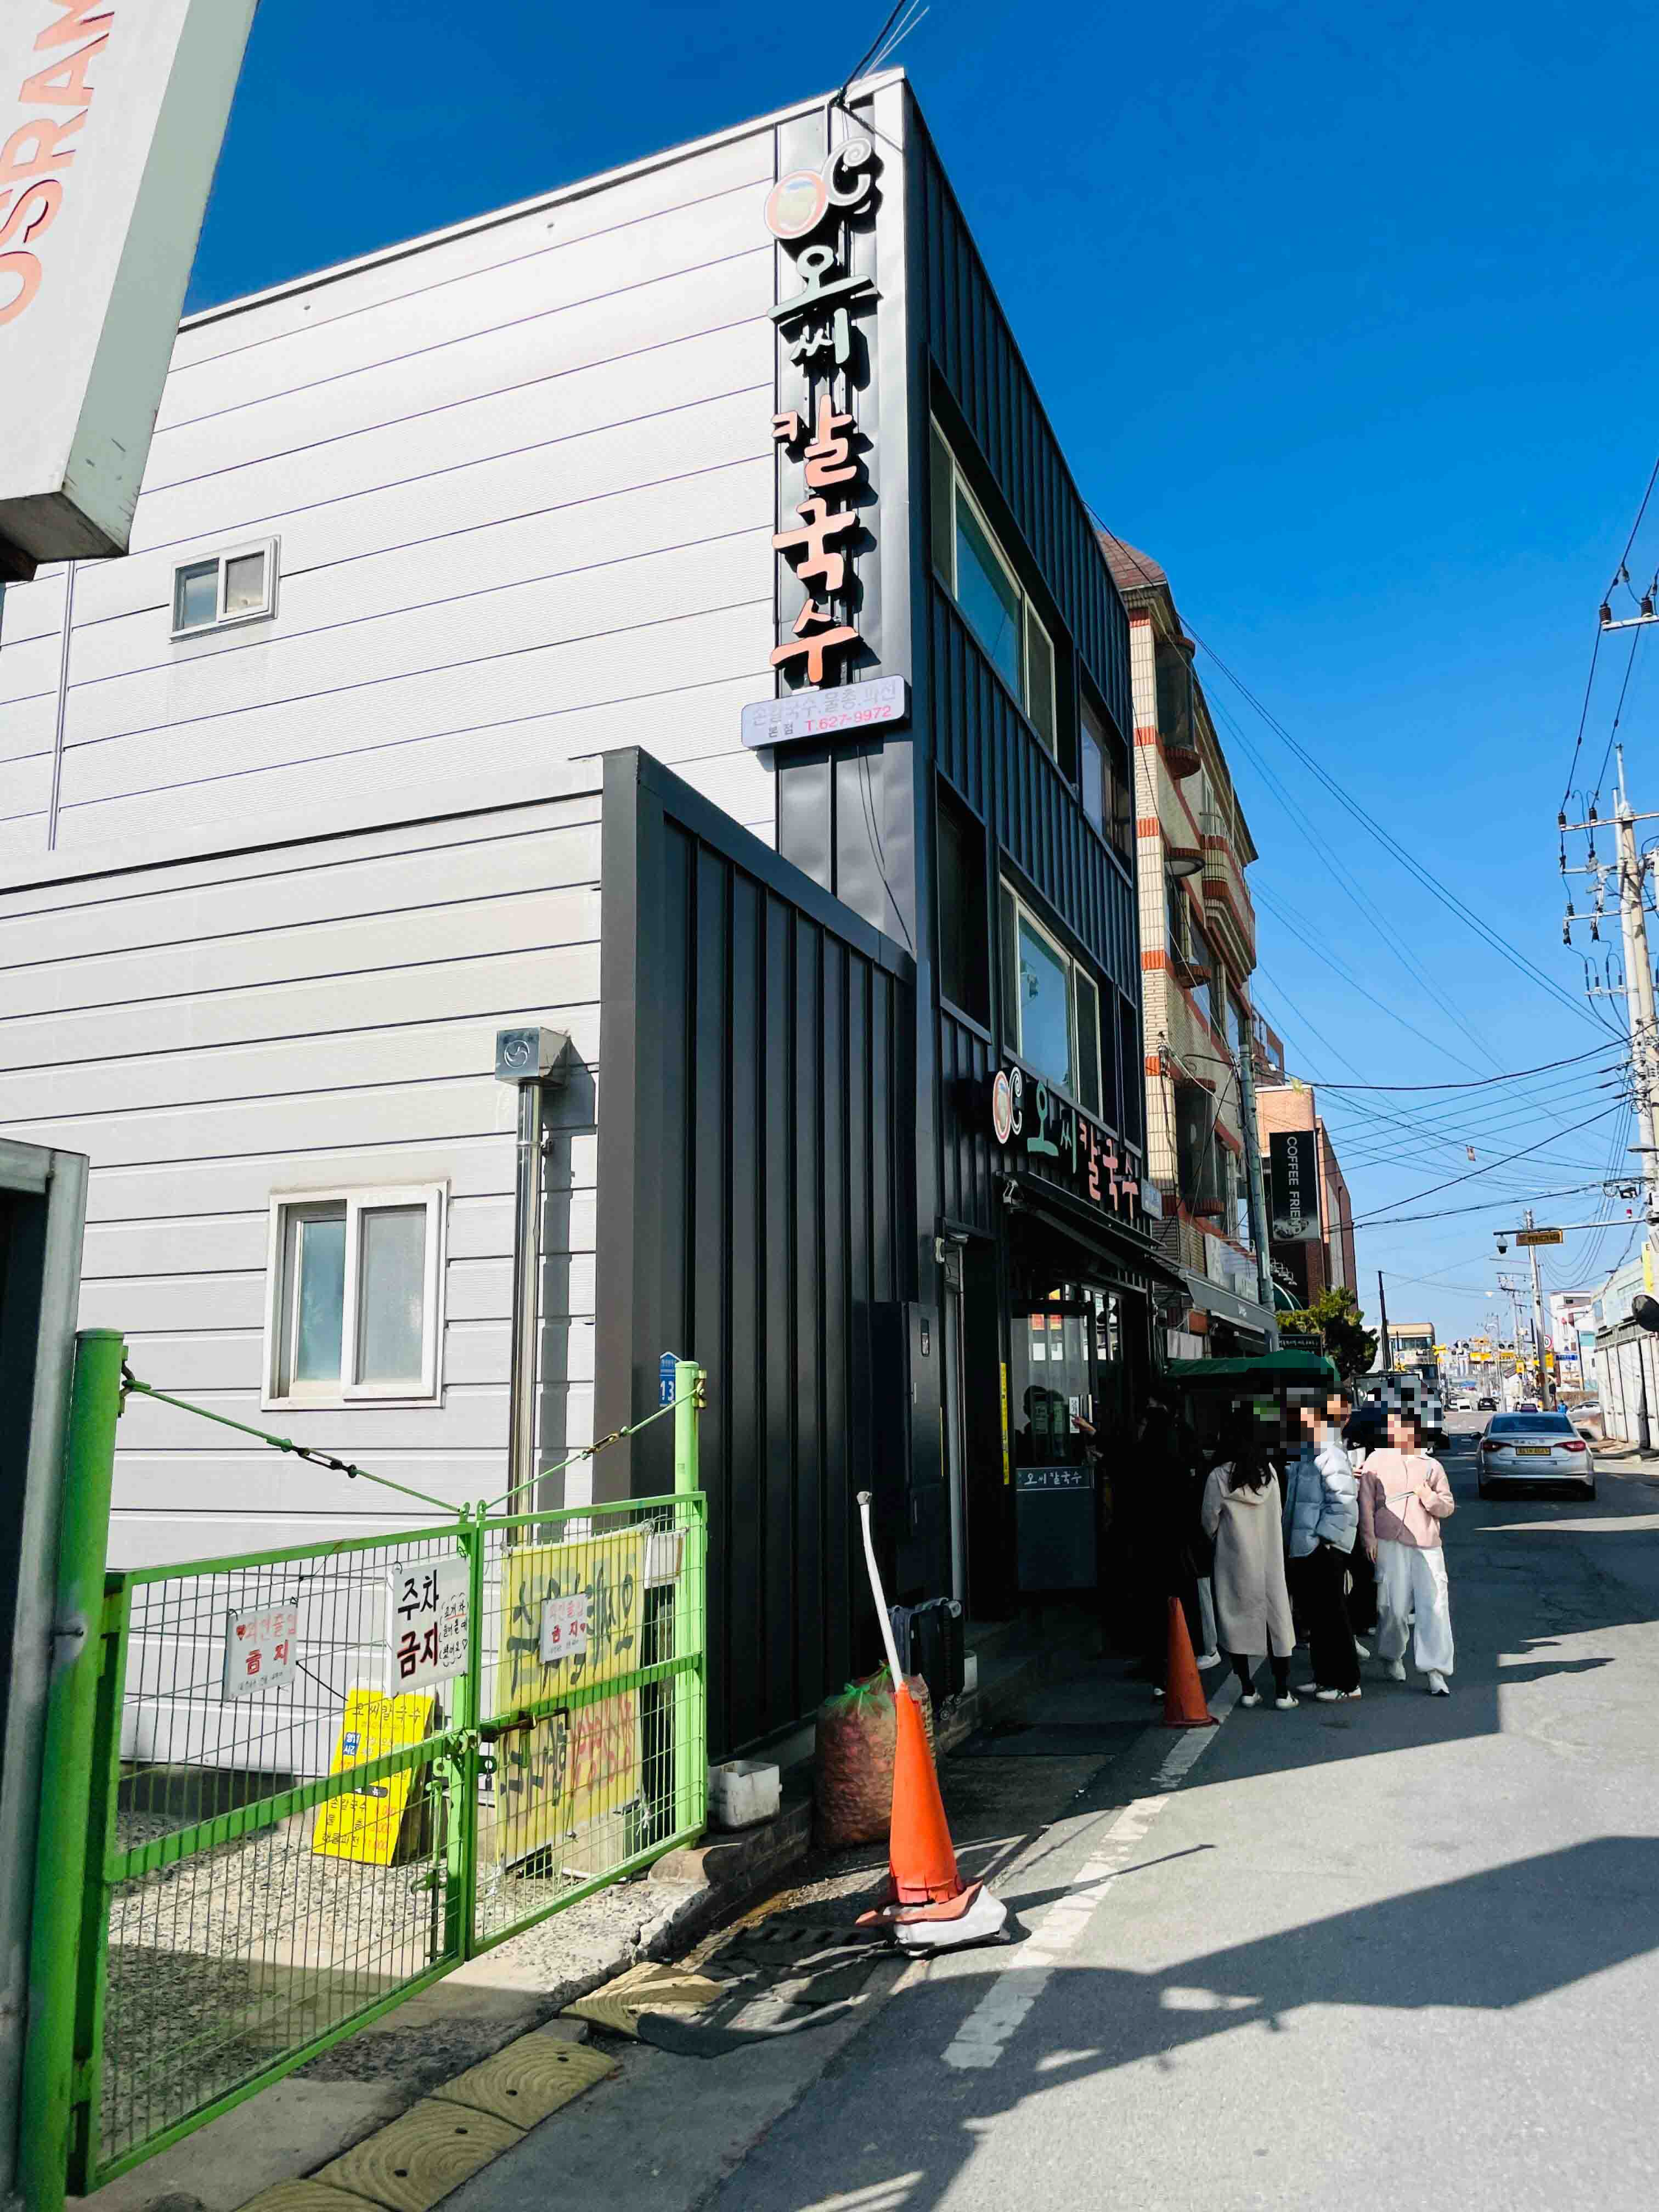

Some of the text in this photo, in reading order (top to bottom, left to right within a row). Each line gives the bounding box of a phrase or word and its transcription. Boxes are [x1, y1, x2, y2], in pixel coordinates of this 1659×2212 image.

[770, 245, 872, 684] 오씨칼국수
[806, 706, 892, 732] T.627-9972
[1026, 1079, 1139, 1220] 오씨칼국수
[1287, 1136, 1299, 1186] COFFEE
[1023, 1472, 1082, 1485] 오씨칼국수
[398, 1568, 439, 1622] 주차
[246, 1638, 290, 1676] 금지
[397, 1621, 439, 1680] 금지
[352, 1703, 421, 1722] 오씨칼국수
